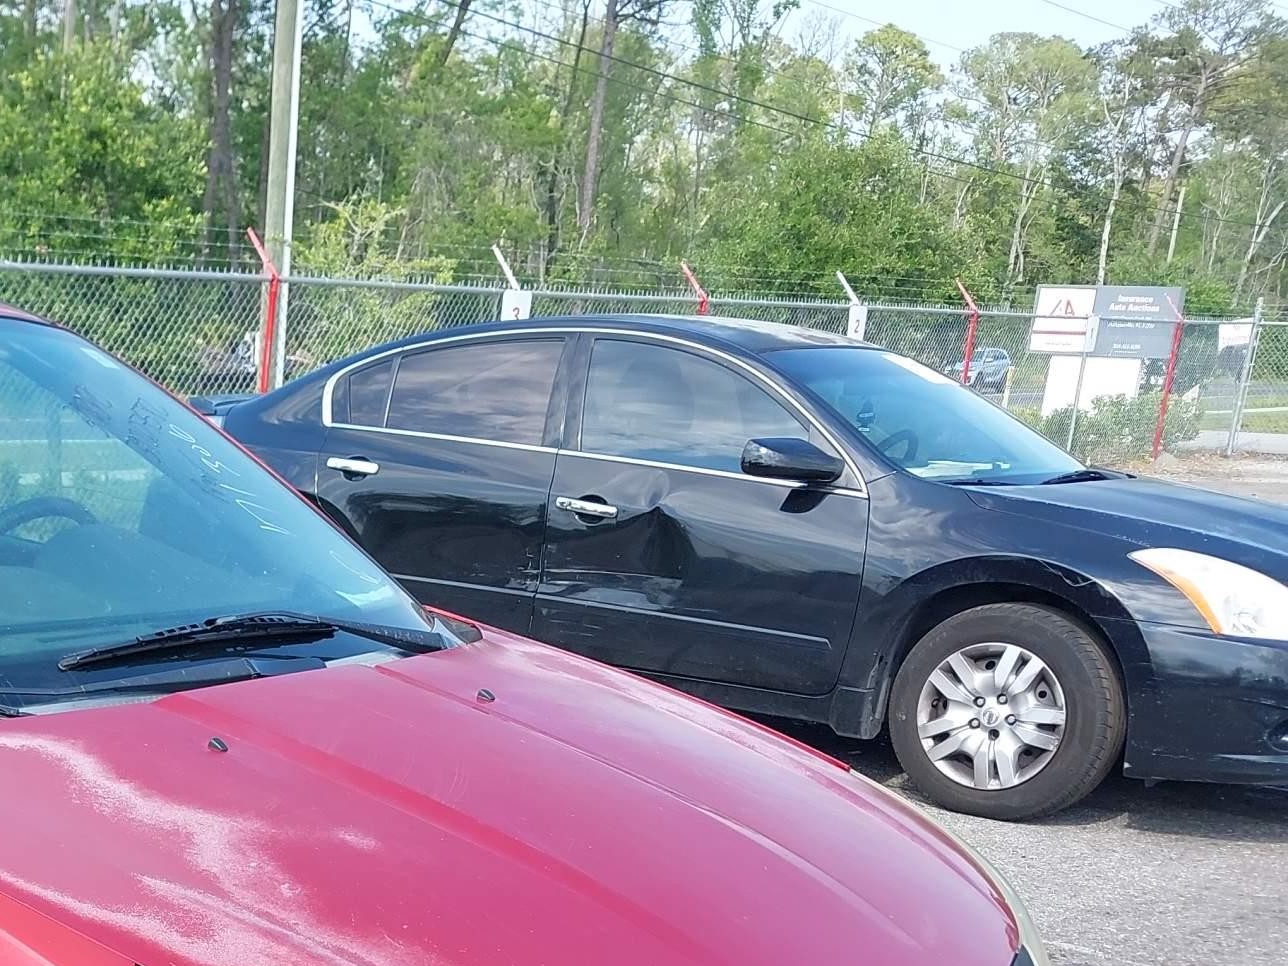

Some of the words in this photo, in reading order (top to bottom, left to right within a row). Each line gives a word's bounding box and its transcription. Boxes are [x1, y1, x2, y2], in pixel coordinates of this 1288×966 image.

[1109, 303, 1126, 311] Auto
[1127, 303, 1160, 312] Auctions
[854, 319, 861, 334] 2
